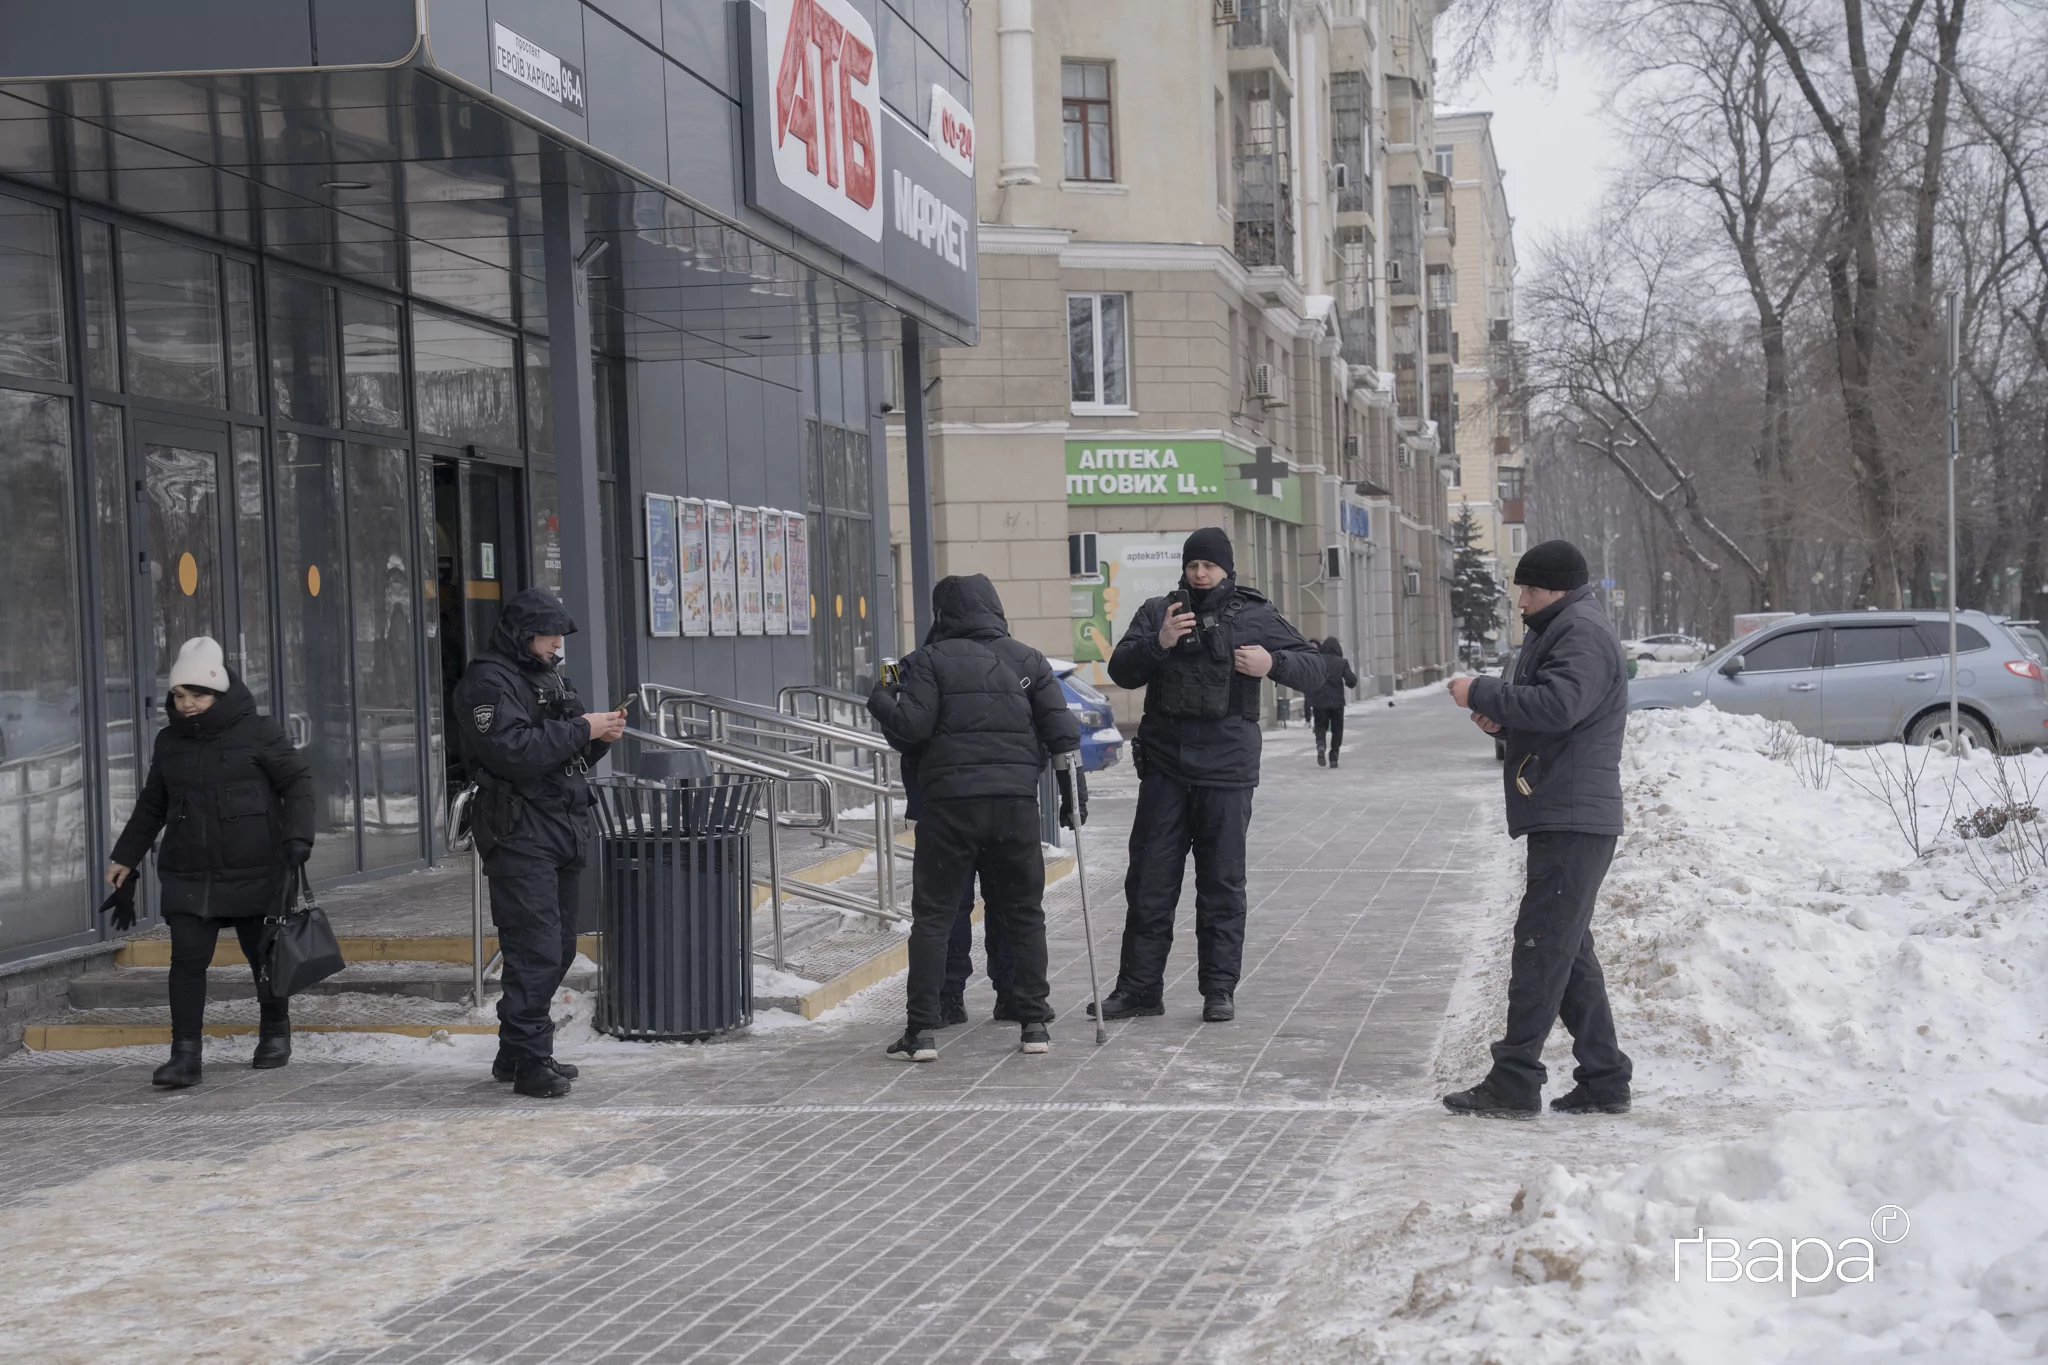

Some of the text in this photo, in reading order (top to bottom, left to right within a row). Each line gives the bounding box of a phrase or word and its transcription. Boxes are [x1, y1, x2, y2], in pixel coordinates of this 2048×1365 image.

[515, 36, 541, 59] проспект
[497, 45, 561, 98] ГЕРОЇВ ХАРКОВА
[561, 66, 583, 108] 96-А
[776, 0, 876, 211] АТБ
[941, 106, 973, 164] 00-24
[893, 169, 968, 272] МАРКЕТ
[1078, 448, 1180, 470] АПТЕКА
[1126, 551, 1182, 563] apteka911.ua
